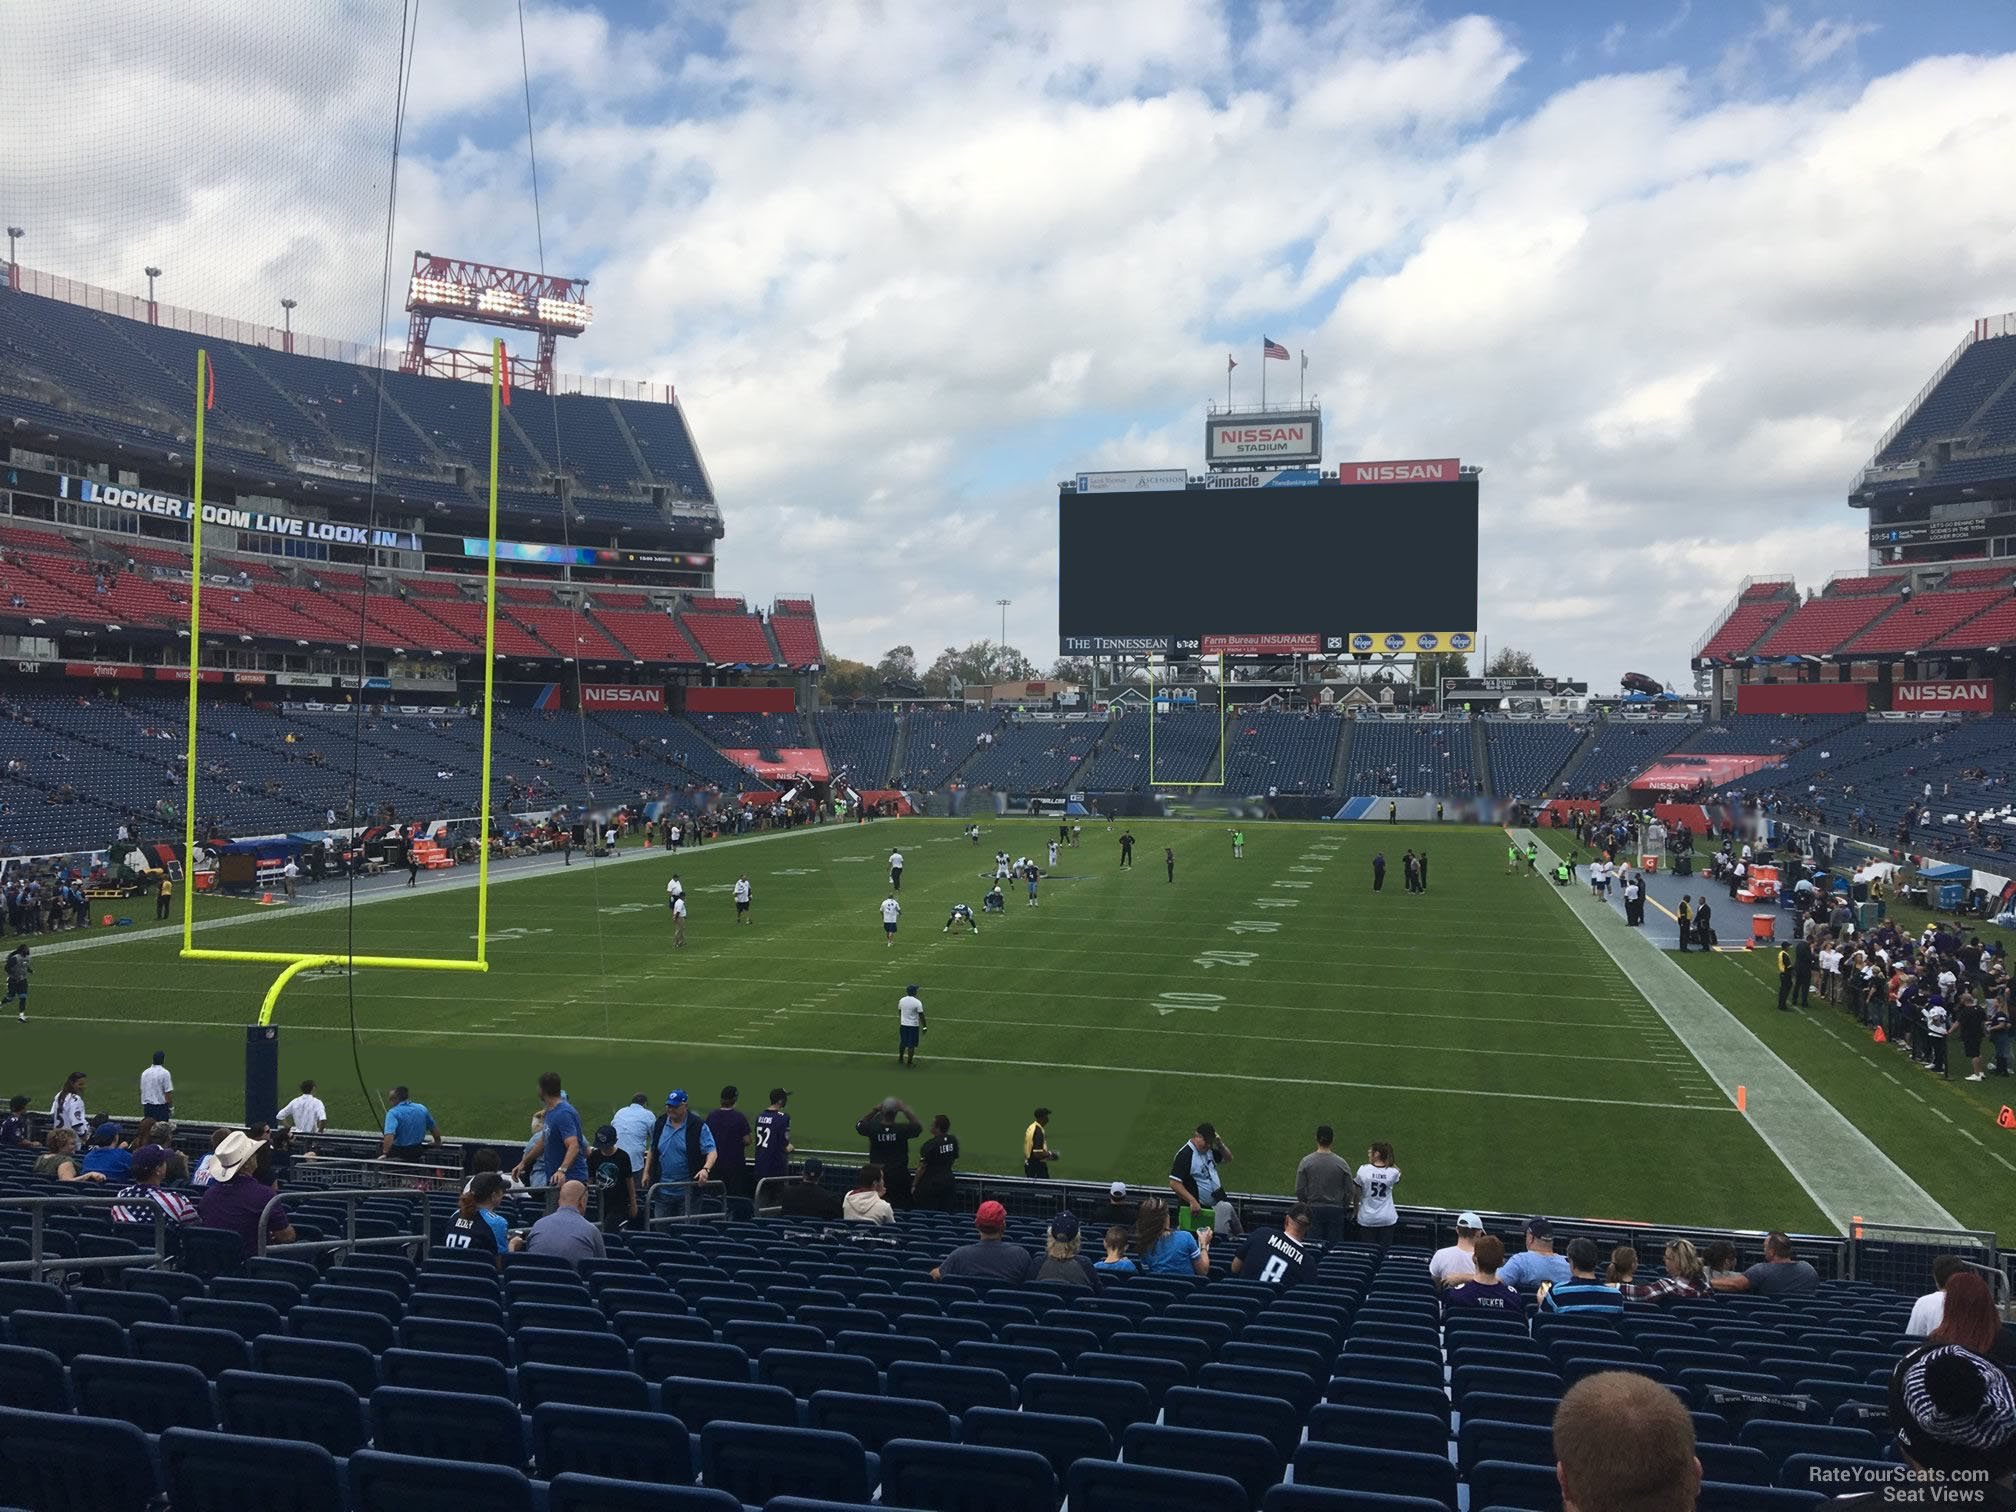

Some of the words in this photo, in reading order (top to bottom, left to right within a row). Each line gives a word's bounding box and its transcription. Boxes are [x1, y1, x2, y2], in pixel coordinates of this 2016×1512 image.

[1221, 428, 1304, 444] NISSAN
[1237, 443, 1288, 452] STADIUM
[1356, 464, 1443, 481] NISSAN
[1207, 474, 1261, 489] Pinnacle
[91, 484, 182, 517] LOCKER
[255, 514, 302, 536] LIVE
[308, 521, 369, 544] LOOK
[374, 531, 398, 547] IN
[1066, 637, 1091, 649] THE
[1093, 637, 1168, 649] TENNESSEAN
[1204, 636, 1227, 645] Farm
[1228, 635, 1259, 644] Bureau
[1261, 635, 1318, 644] INSURANCE
[19, 662, 40, 673] CMT
[93, 666, 119, 677] xfinity
[176, 672, 204, 680] NISN
[586, 688, 659, 702] NISSAN
[1899, 685, 1987, 701] NISSAN
[1650, 782, 1688, 790] NISSAN
[2000, 1108, 2009, 1125] G
[756, 1126, 771, 1149] 52
[878, 1134, 897, 1142] LEWIS
[940, 1144, 954, 1153] LEWIS
[1371, 1182, 1386, 1197] 52
[1267, 1234, 1304, 1265] MARIOTA
[1259, 1254, 1289, 1282] 8
[1507, 1285, 1518, 1294] 9
[1477, 1297, 1504, 1308] TUCKER
